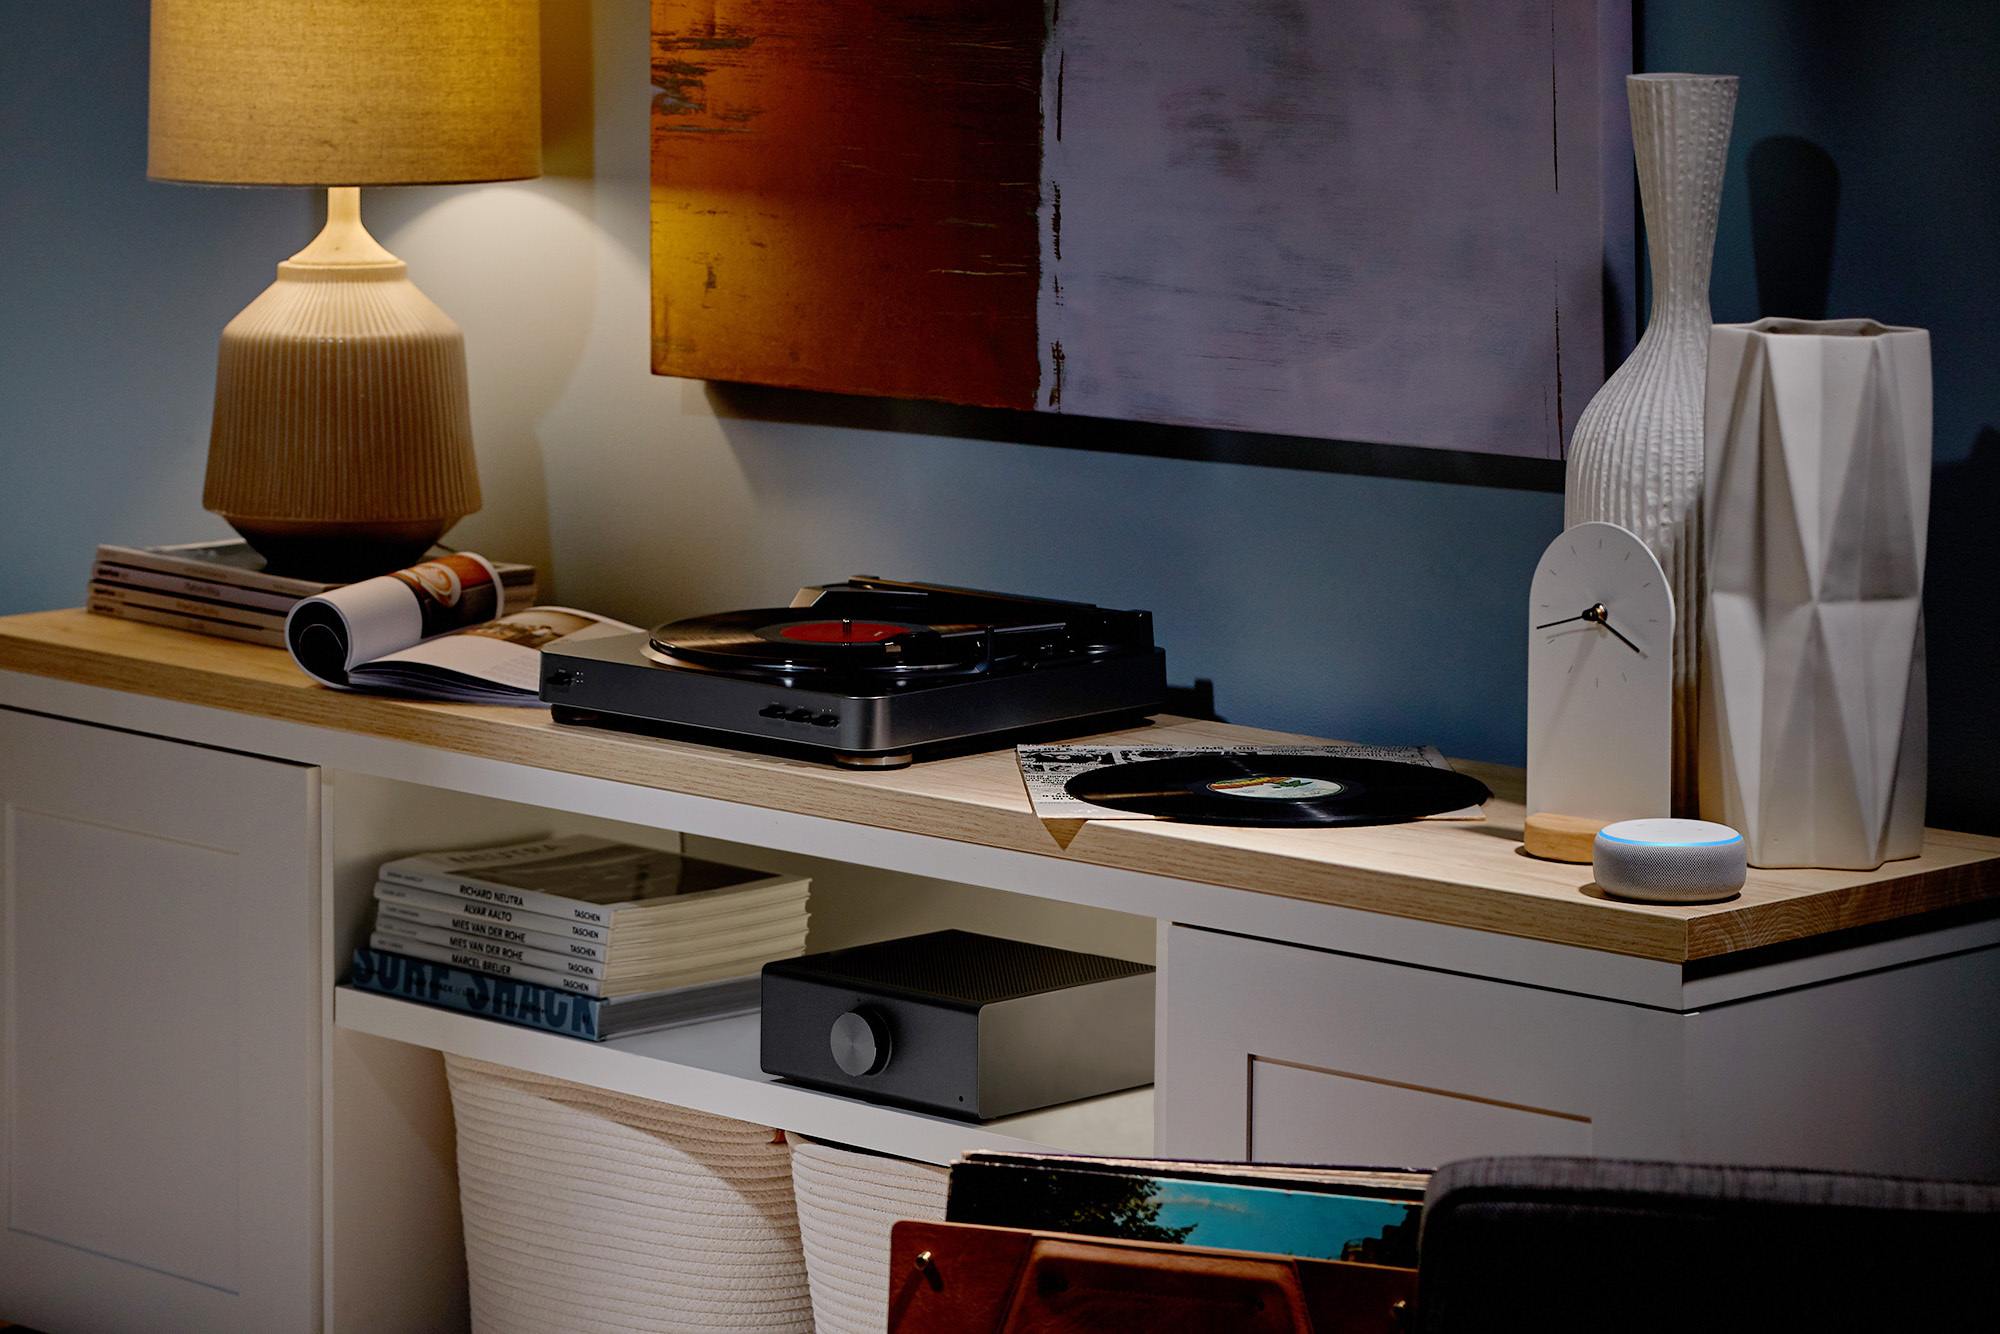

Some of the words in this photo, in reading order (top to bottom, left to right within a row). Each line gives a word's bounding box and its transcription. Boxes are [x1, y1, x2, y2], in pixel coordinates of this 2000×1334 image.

[460, 884, 492, 900] RICHARD
[494, 891, 523, 907] NEUTRA
[464, 903, 487, 916] ALVAR
[488, 909, 512, 922] AALTO
[574, 909, 601, 922] TASCHEN
[452, 918, 469, 930] MIES
[471, 922, 486, 934] VAN
[488, 926, 503, 938] DER
[505, 931, 526, 943] ROHE
[572, 926, 599, 939] TASCHEN
[449, 936, 467, 949] MIES
[468, 940, 484, 952] VAN
[486, 944, 500, 956] DER
[502, 948, 523, 960] ROHE
[570, 944, 596, 956] TASCHEN
[452, 954, 480, 969] MARCEL
[482, 960, 511, 975] BREUER
[568, 962, 594, 975] TASCHEN
[352, 948, 450, 1000] SURF
[466, 973, 596, 1036] SHACK
[563, 978, 589, 992] TASCHEN
